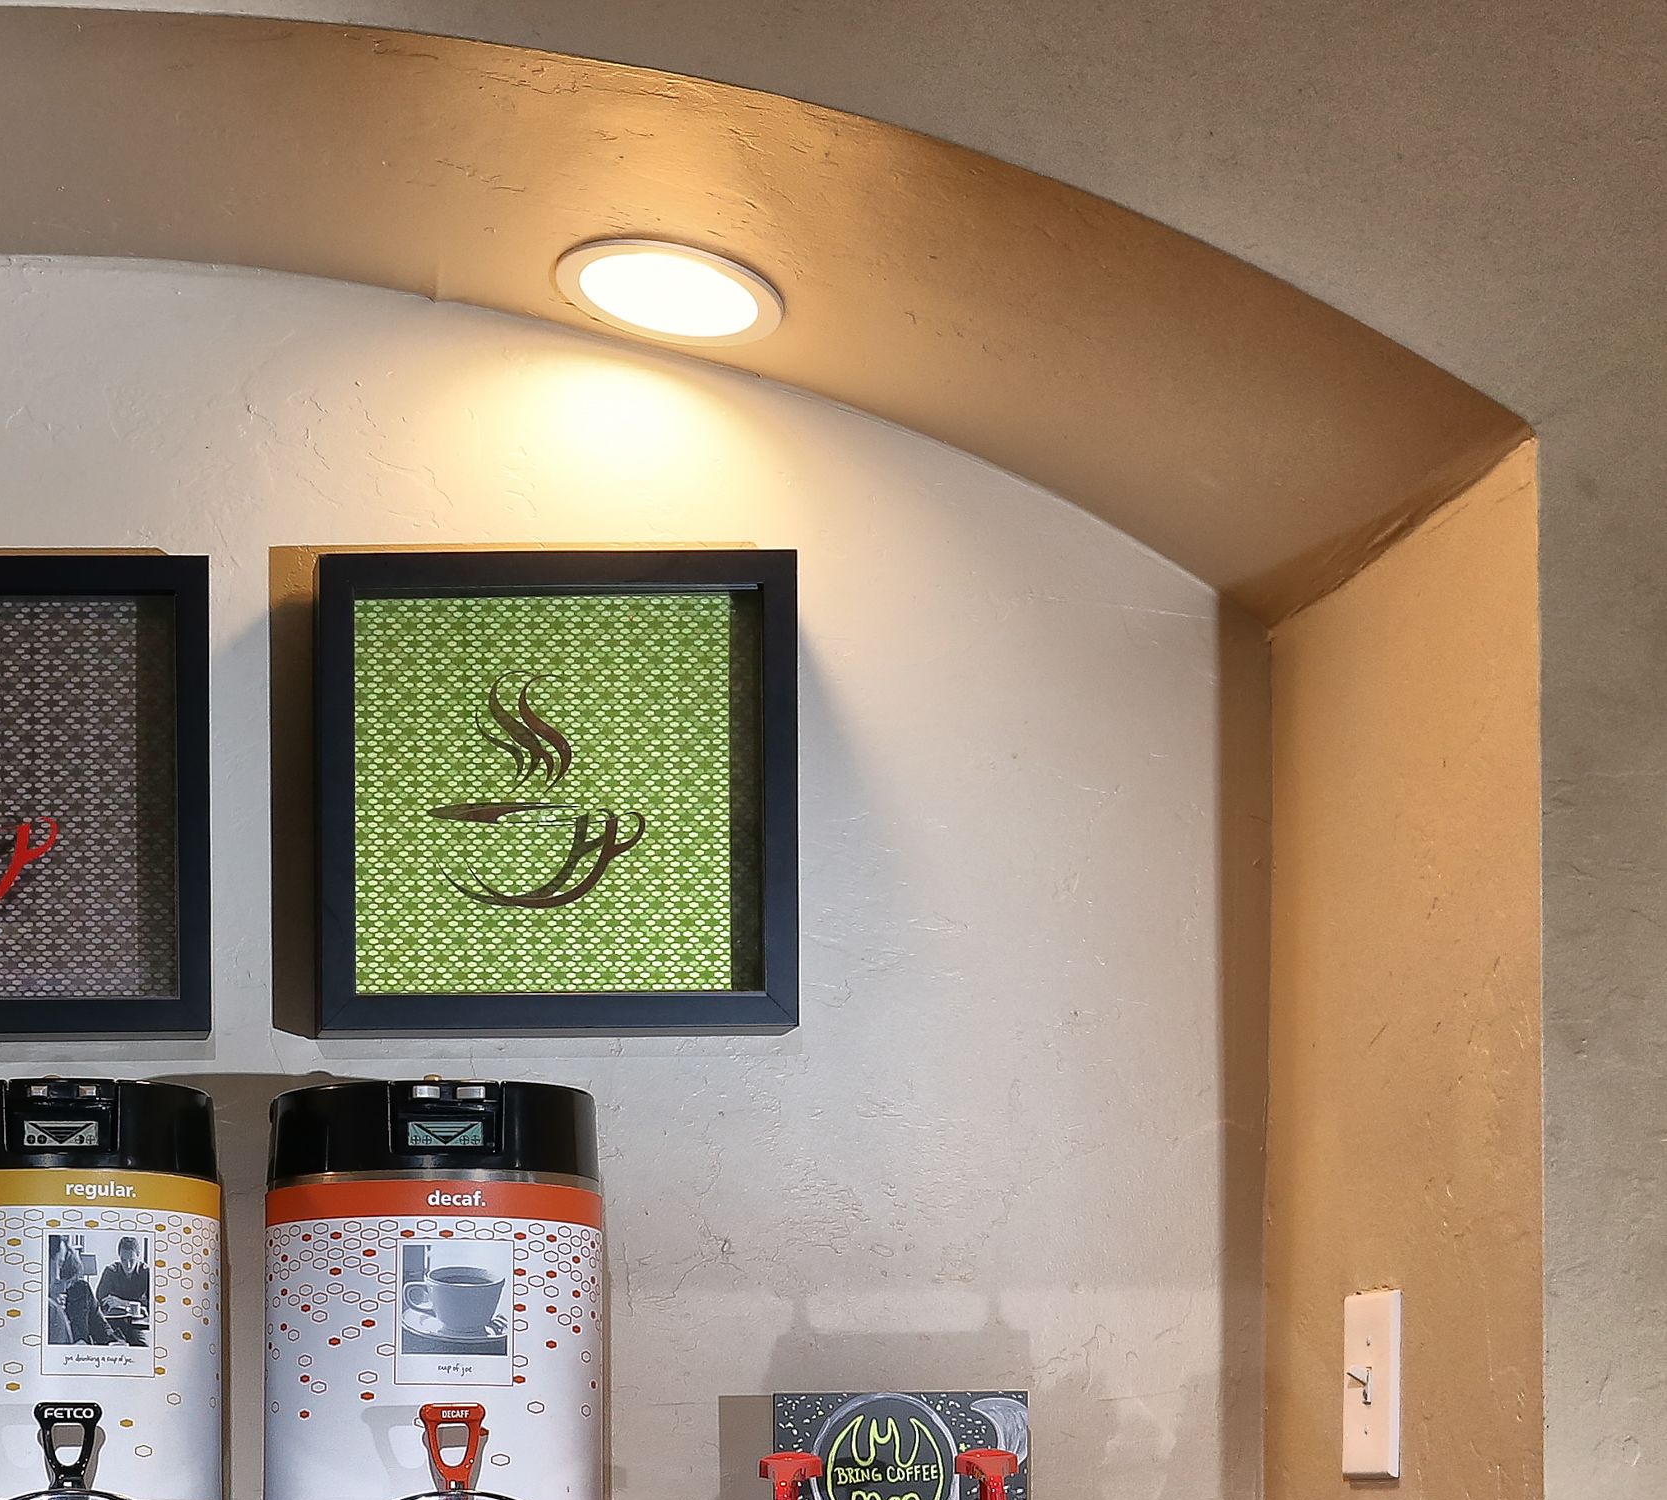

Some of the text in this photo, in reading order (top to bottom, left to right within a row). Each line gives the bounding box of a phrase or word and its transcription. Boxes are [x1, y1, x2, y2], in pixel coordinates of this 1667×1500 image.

[65, 1180, 137, 1200] regular.
[426, 1189, 487, 1207] decaf.
[43, 1407, 94, 1419] FETCO
[441, 1409, 470, 1419] DECAFF
[833, 1463, 939, 1485] BRING COFFEE
